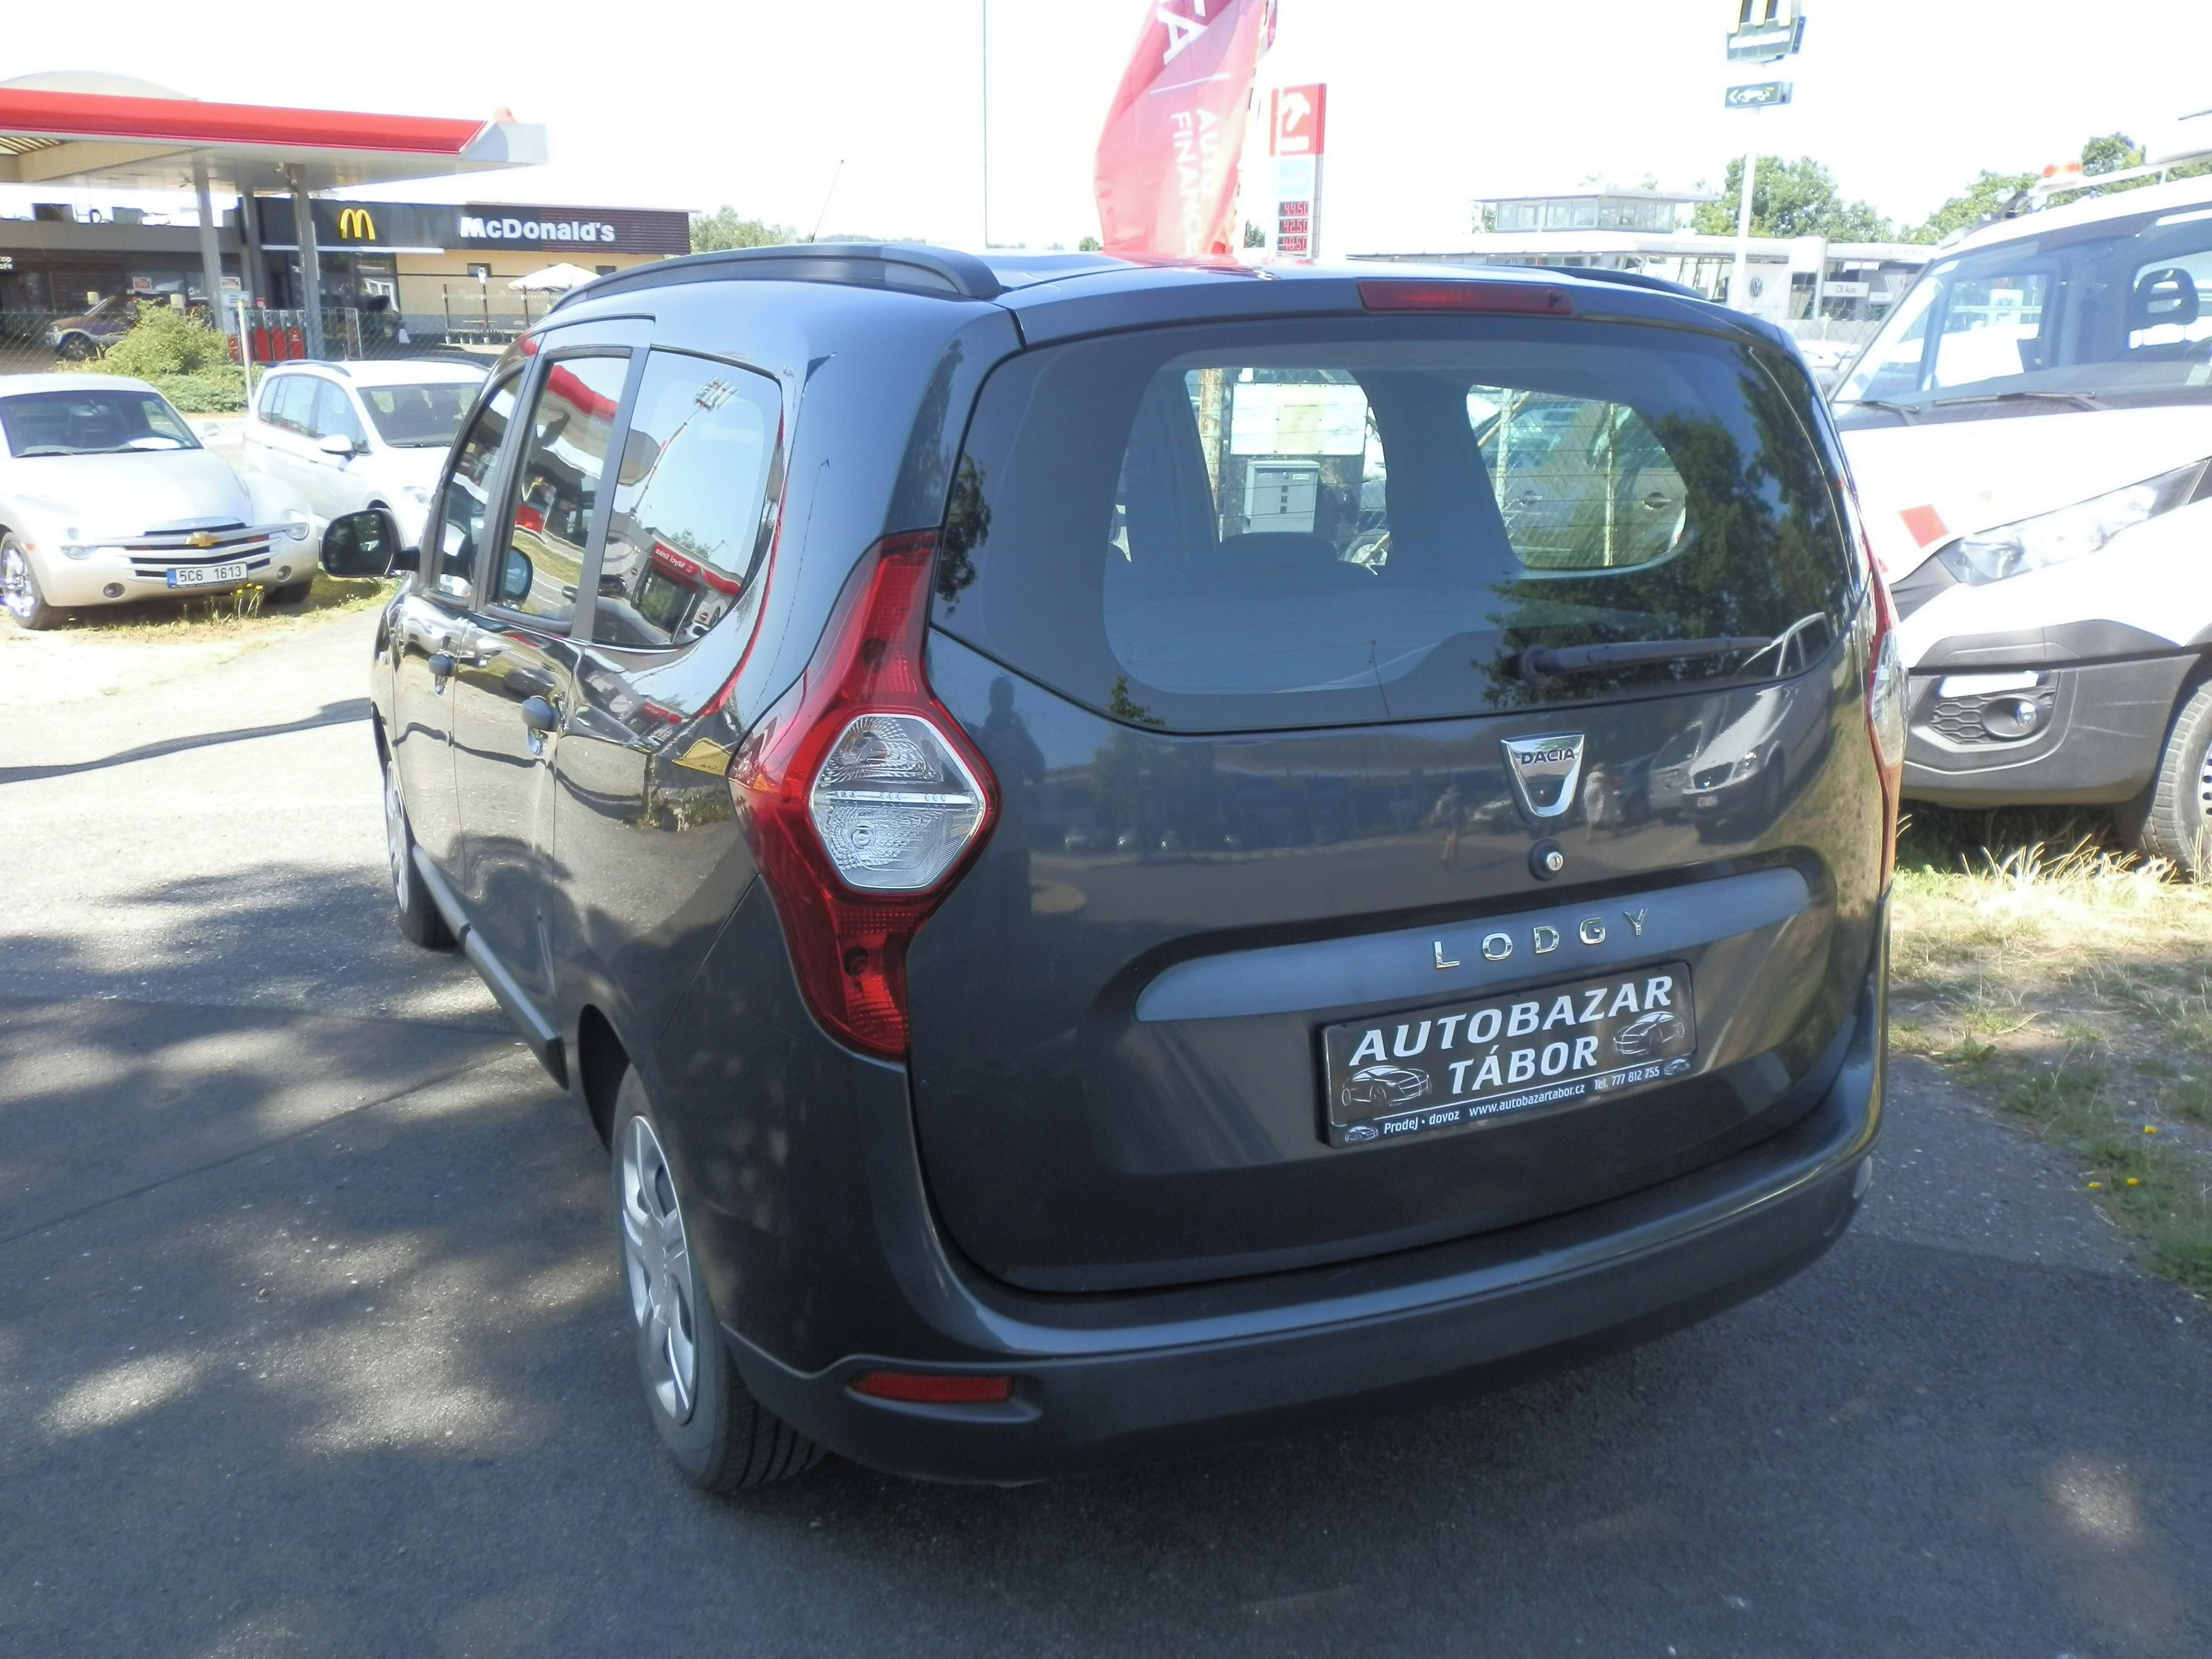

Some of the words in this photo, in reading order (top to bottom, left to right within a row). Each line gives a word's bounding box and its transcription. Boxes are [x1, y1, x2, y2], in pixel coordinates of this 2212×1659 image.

[1170, 111, 1202, 254] FINANCE
[460, 216, 615, 242] McDonald's
[179, 569, 204, 582] 5C6
[213, 565, 241, 579] 1613
[1521, 747, 1575, 765] DACIA
[1432, 907, 1648, 969] LODGY
[1348, 975, 1673, 1066] AUTOBAZAR
[1448, 1036, 1599, 1095] TÁBOR
[1384, 1116, 1419, 1134] Prodej
[1429, 1110, 1459, 1125] dovoz
[1469, 1083, 1585, 1116] www.autobazartabor.cz
[1594, 1079, 1608, 1090] Tel.
[1611, 1075, 1626, 1087] 777
[1628, 1071, 1642, 1083] 812
[1645, 1066, 1660, 1079] 755
